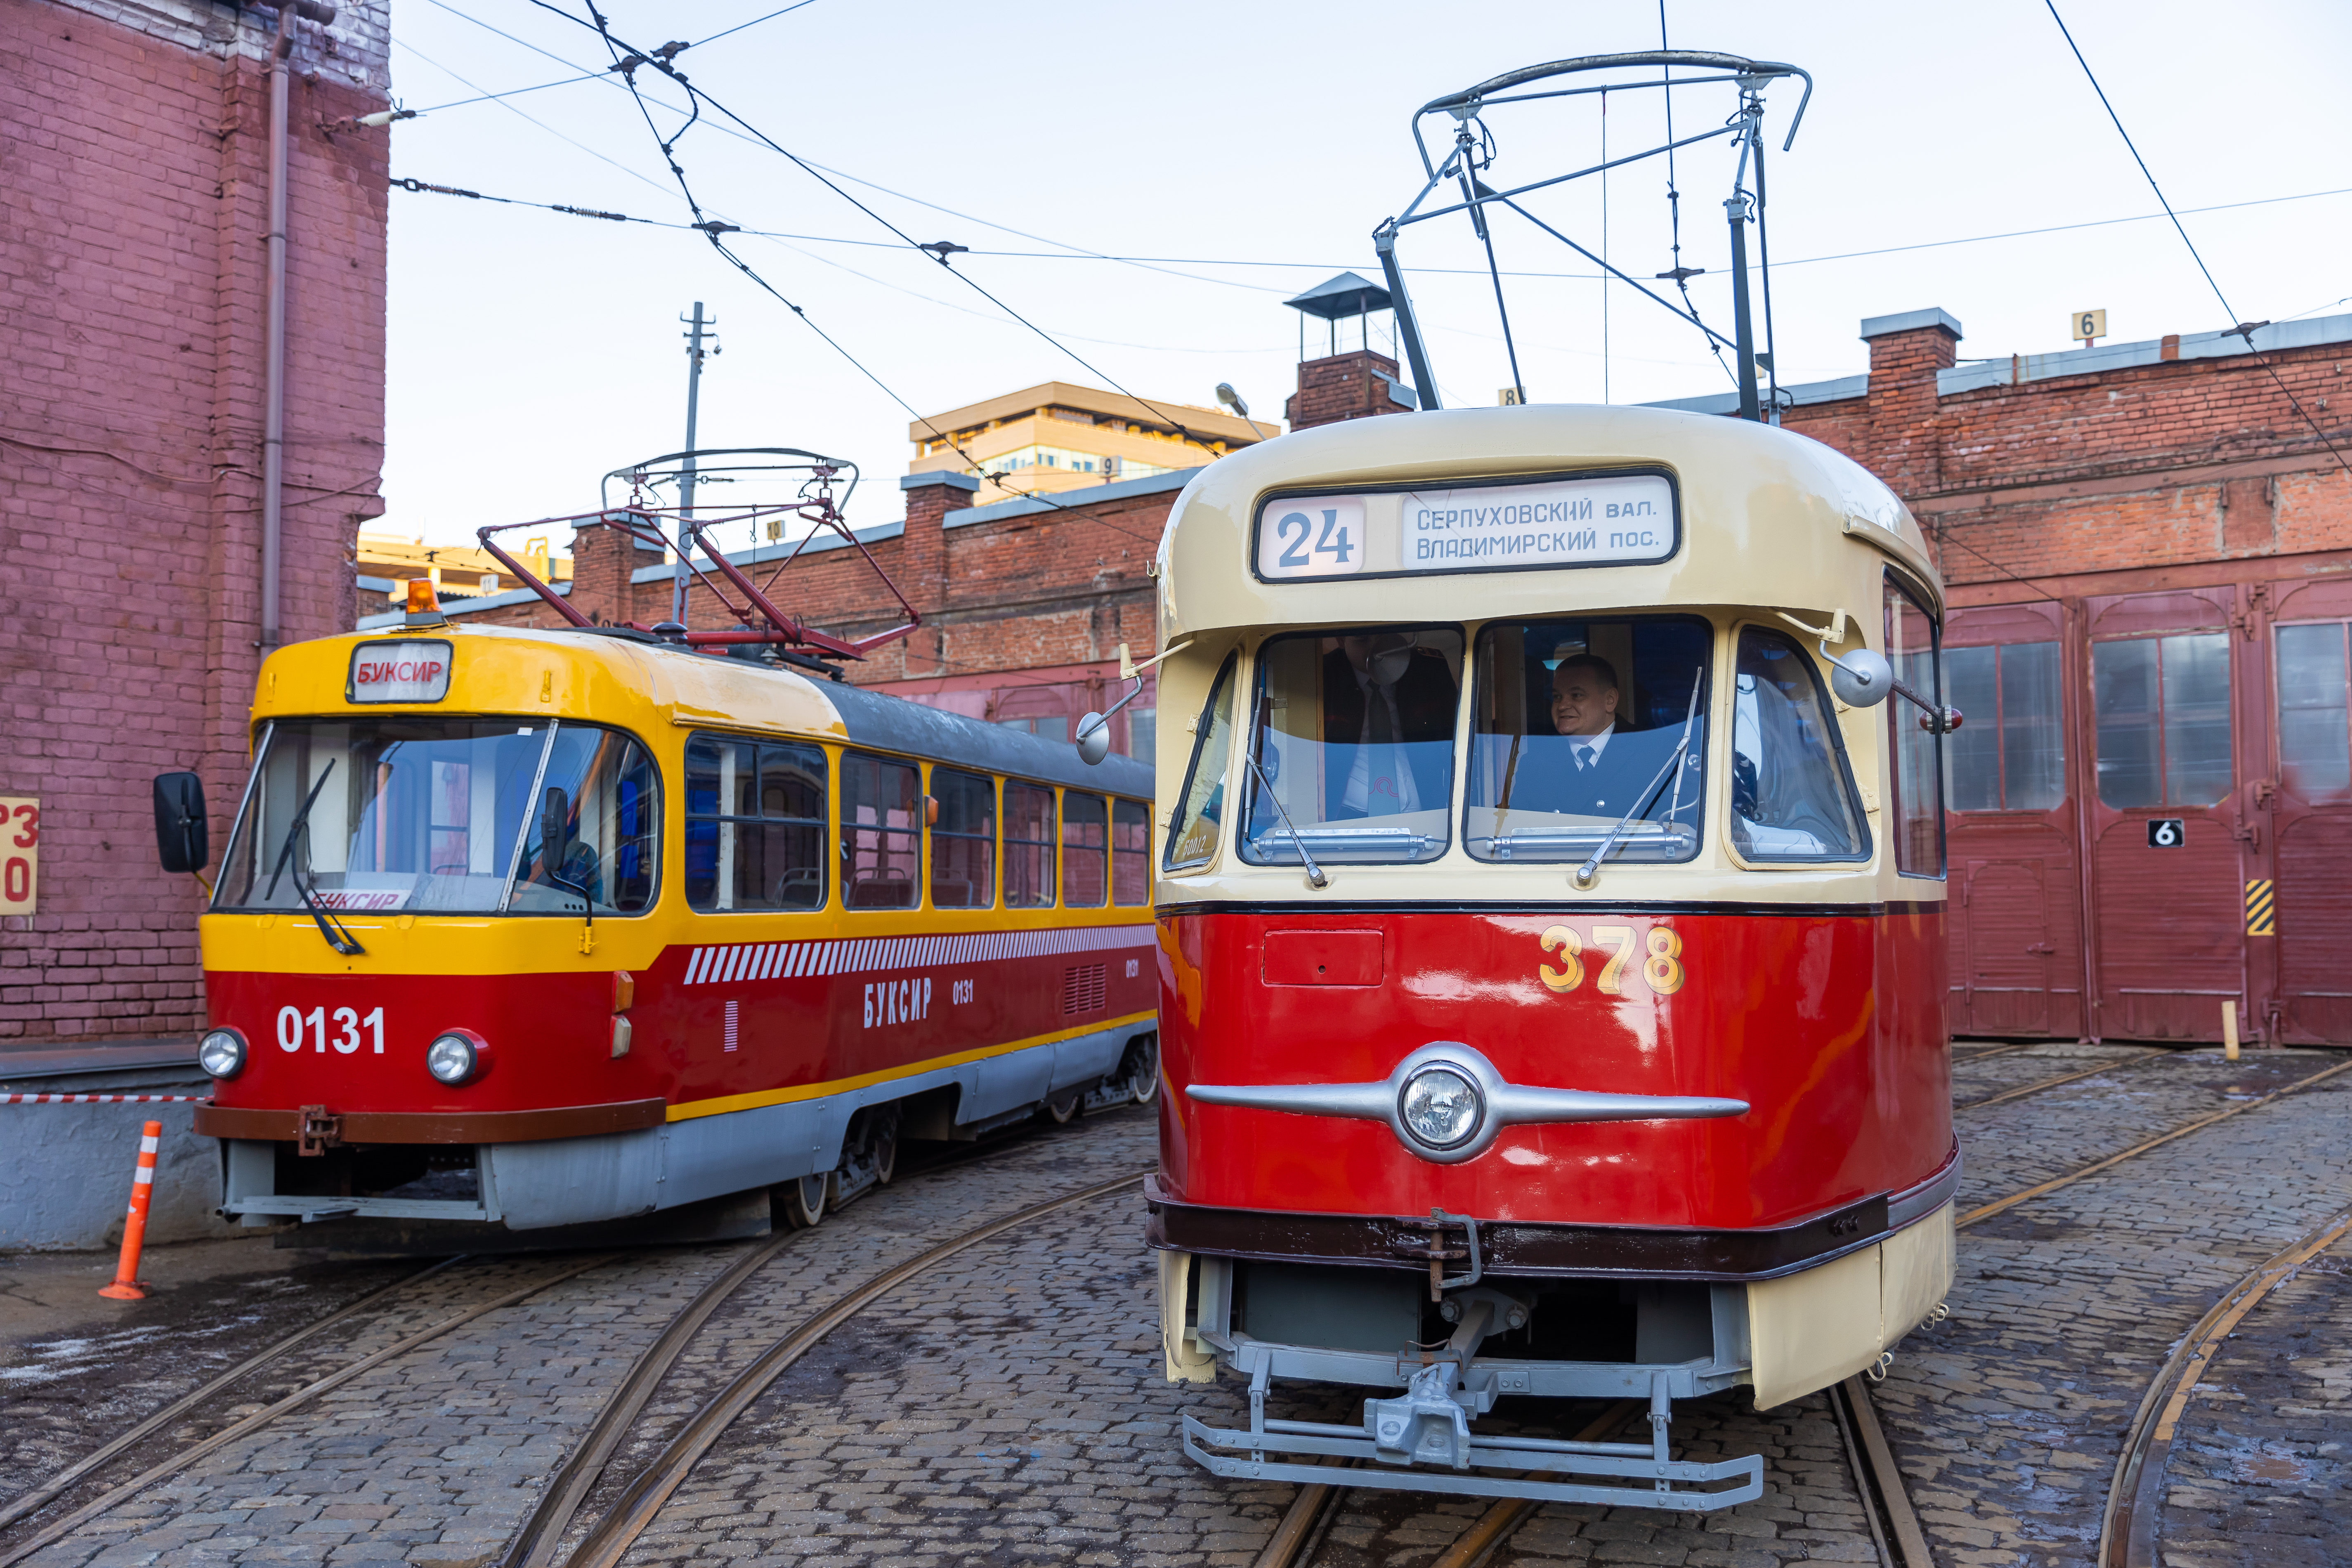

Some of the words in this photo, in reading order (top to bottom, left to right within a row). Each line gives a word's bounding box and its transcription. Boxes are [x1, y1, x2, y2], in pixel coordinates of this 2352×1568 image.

[2081, 313, 2094, 336] 6
[1505, 390, 1515, 406] 8
[1104, 458, 1112, 475] 9
[1417, 497, 1592, 531] СЕРПУХОВСКИЙ
[1606, 501, 1657, 518] ВАЛ.
[768, 522, 779, 538] 10
[1277, 509, 1354, 568] 24
[1417, 527, 1596, 560] ВЛАДИМИРСКИЙ
[1610, 531, 1659, 548] ПОС.
[357, 661, 442, 683] БУКСИР
[2155, 821, 2175, 845] 6
[1183, 835, 1207, 857] 50012
[1126, 959, 1139, 978] 0131
[1539, 924, 1685, 995] 378
[864, 977, 931, 1029] БУКСИР
[953, 978, 973, 1005] 0131
[277, 1005, 385, 1054] 0131
